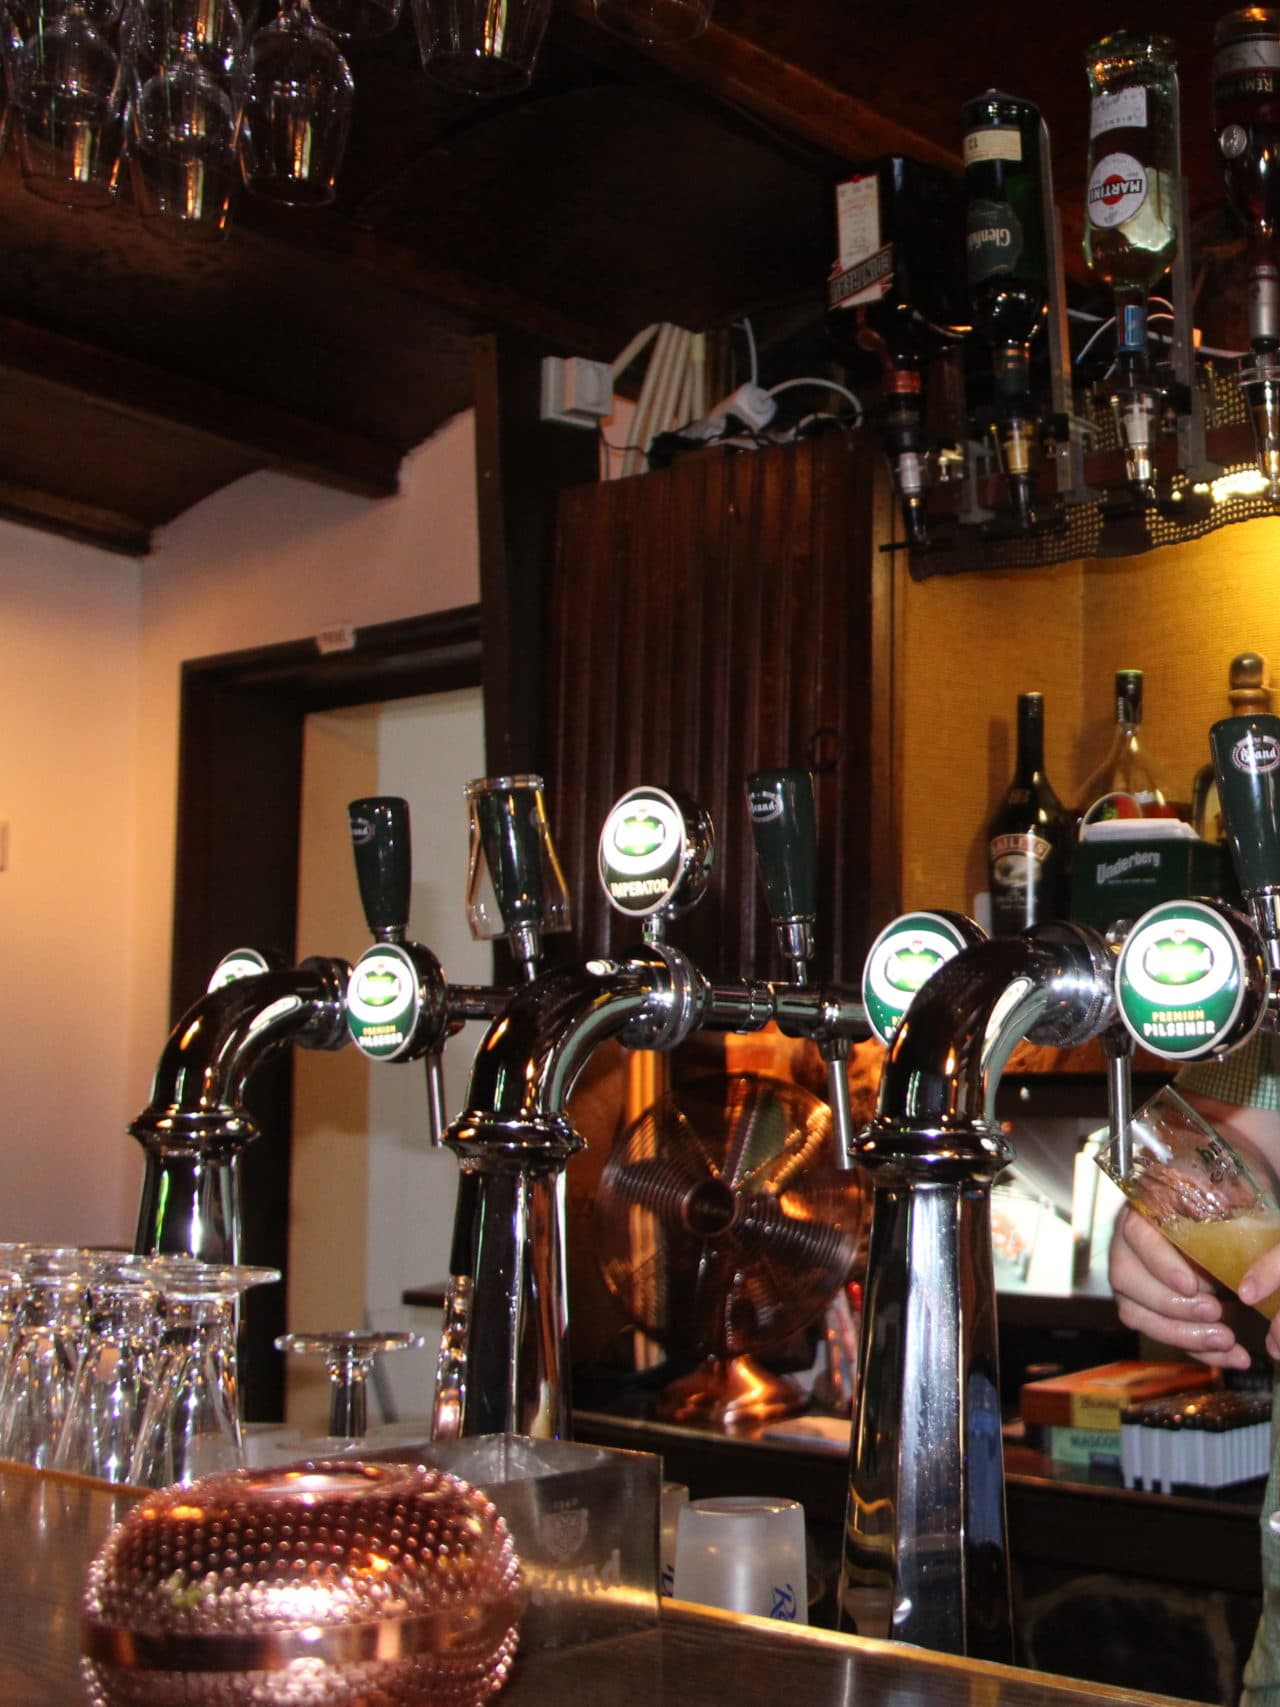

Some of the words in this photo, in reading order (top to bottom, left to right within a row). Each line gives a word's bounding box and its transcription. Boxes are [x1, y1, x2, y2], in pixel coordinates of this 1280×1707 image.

[1090, 179, 1142, 204] MARTINI
[1240, 747, 1277, 764] Band
[1096, 851, 1161, 885] Underberg
[610, 878, 669, 898] IMPERATOR
[1152, 1010, 1205, 1022] PREMIUM
[1143, 1020, 1216, 1037] PILSENER
